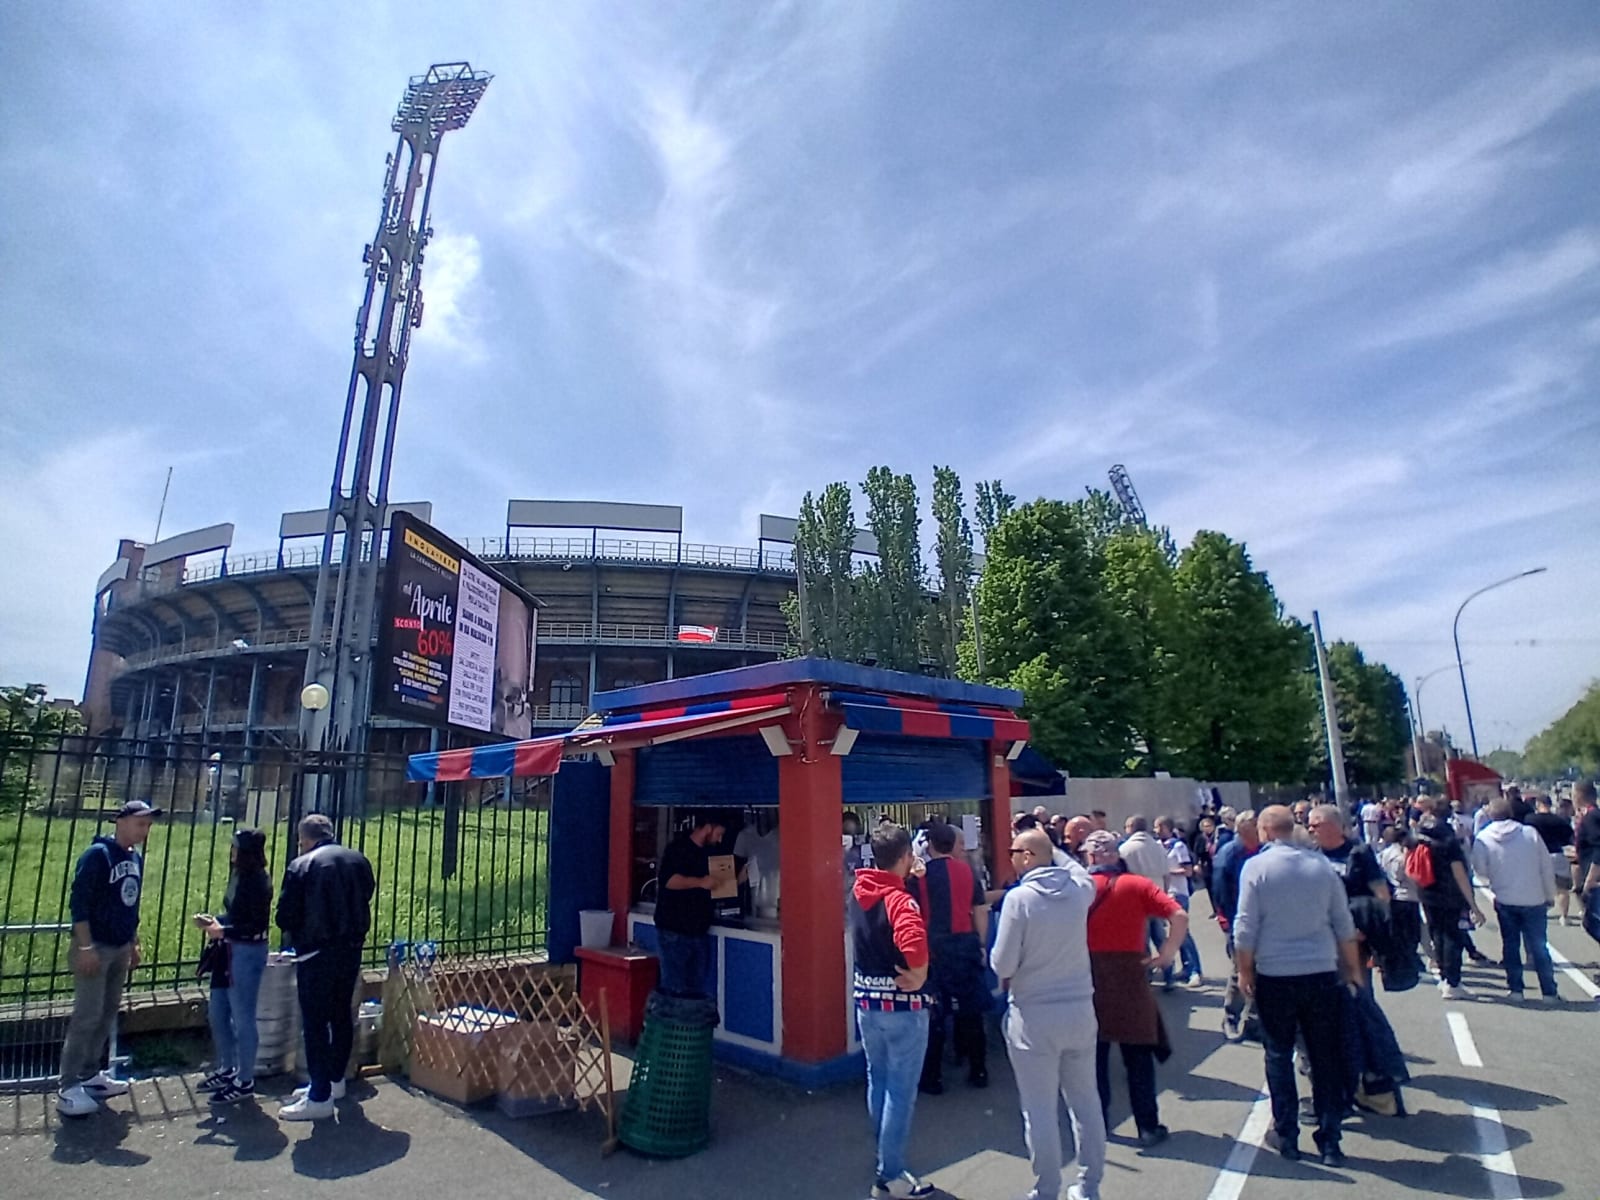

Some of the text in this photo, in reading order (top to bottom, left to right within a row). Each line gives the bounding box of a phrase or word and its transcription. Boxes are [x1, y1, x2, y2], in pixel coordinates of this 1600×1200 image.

[410, 584, 453, 631] Aprile
[394, 617, 421, 629] SCONTO
[418, 630, 452, 656] 60%
